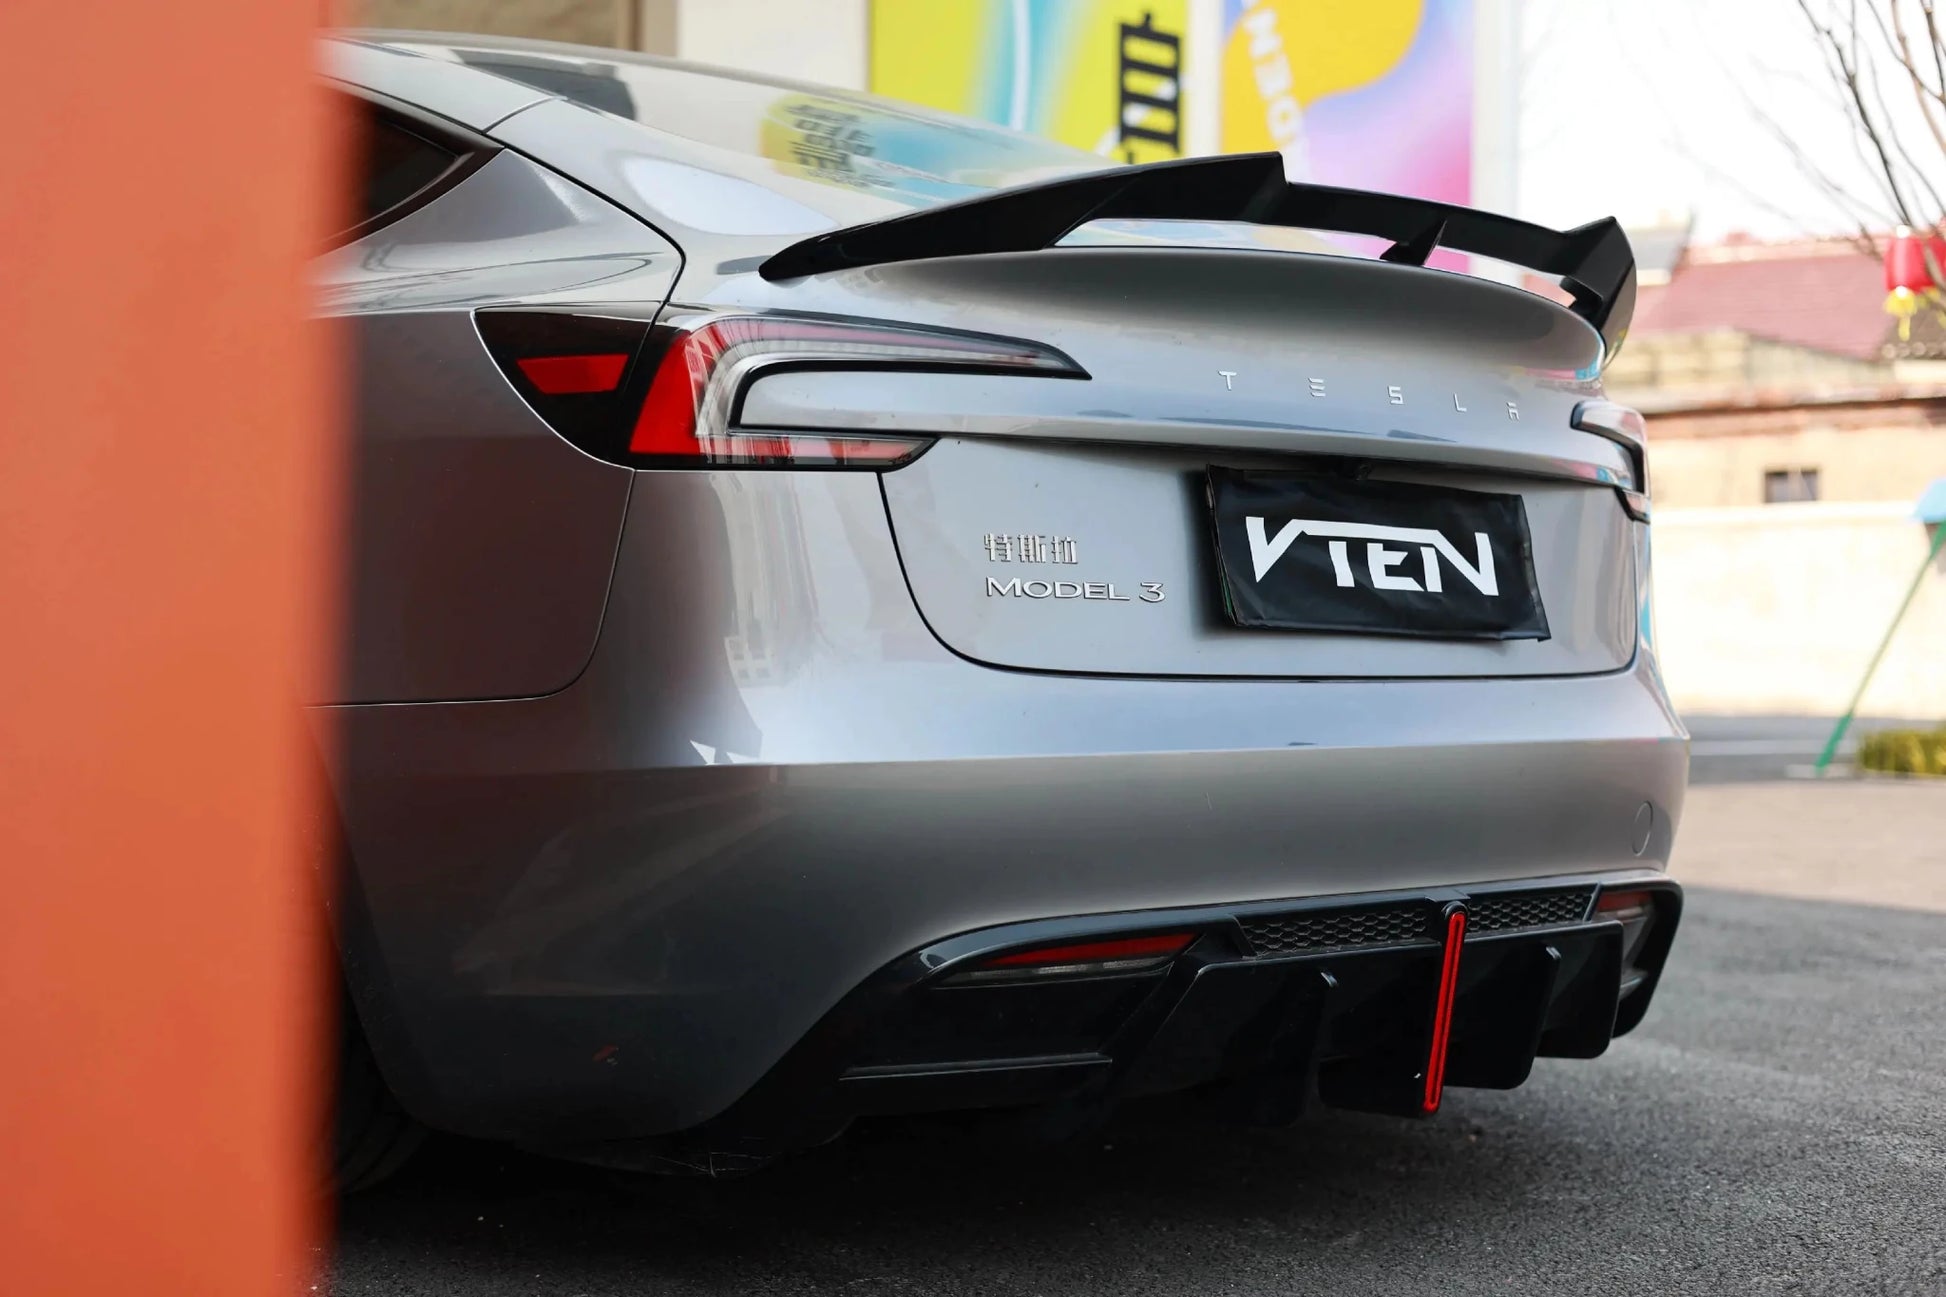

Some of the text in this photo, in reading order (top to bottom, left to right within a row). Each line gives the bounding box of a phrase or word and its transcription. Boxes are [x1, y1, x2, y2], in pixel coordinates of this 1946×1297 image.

[1218, 370, 1520, 421] TESLA
[983, 532, 1079, 565] 特斯拉
[1245, 515, 1500, 597] VTEN
[985, 575, 1166, 603] MODEL 3
